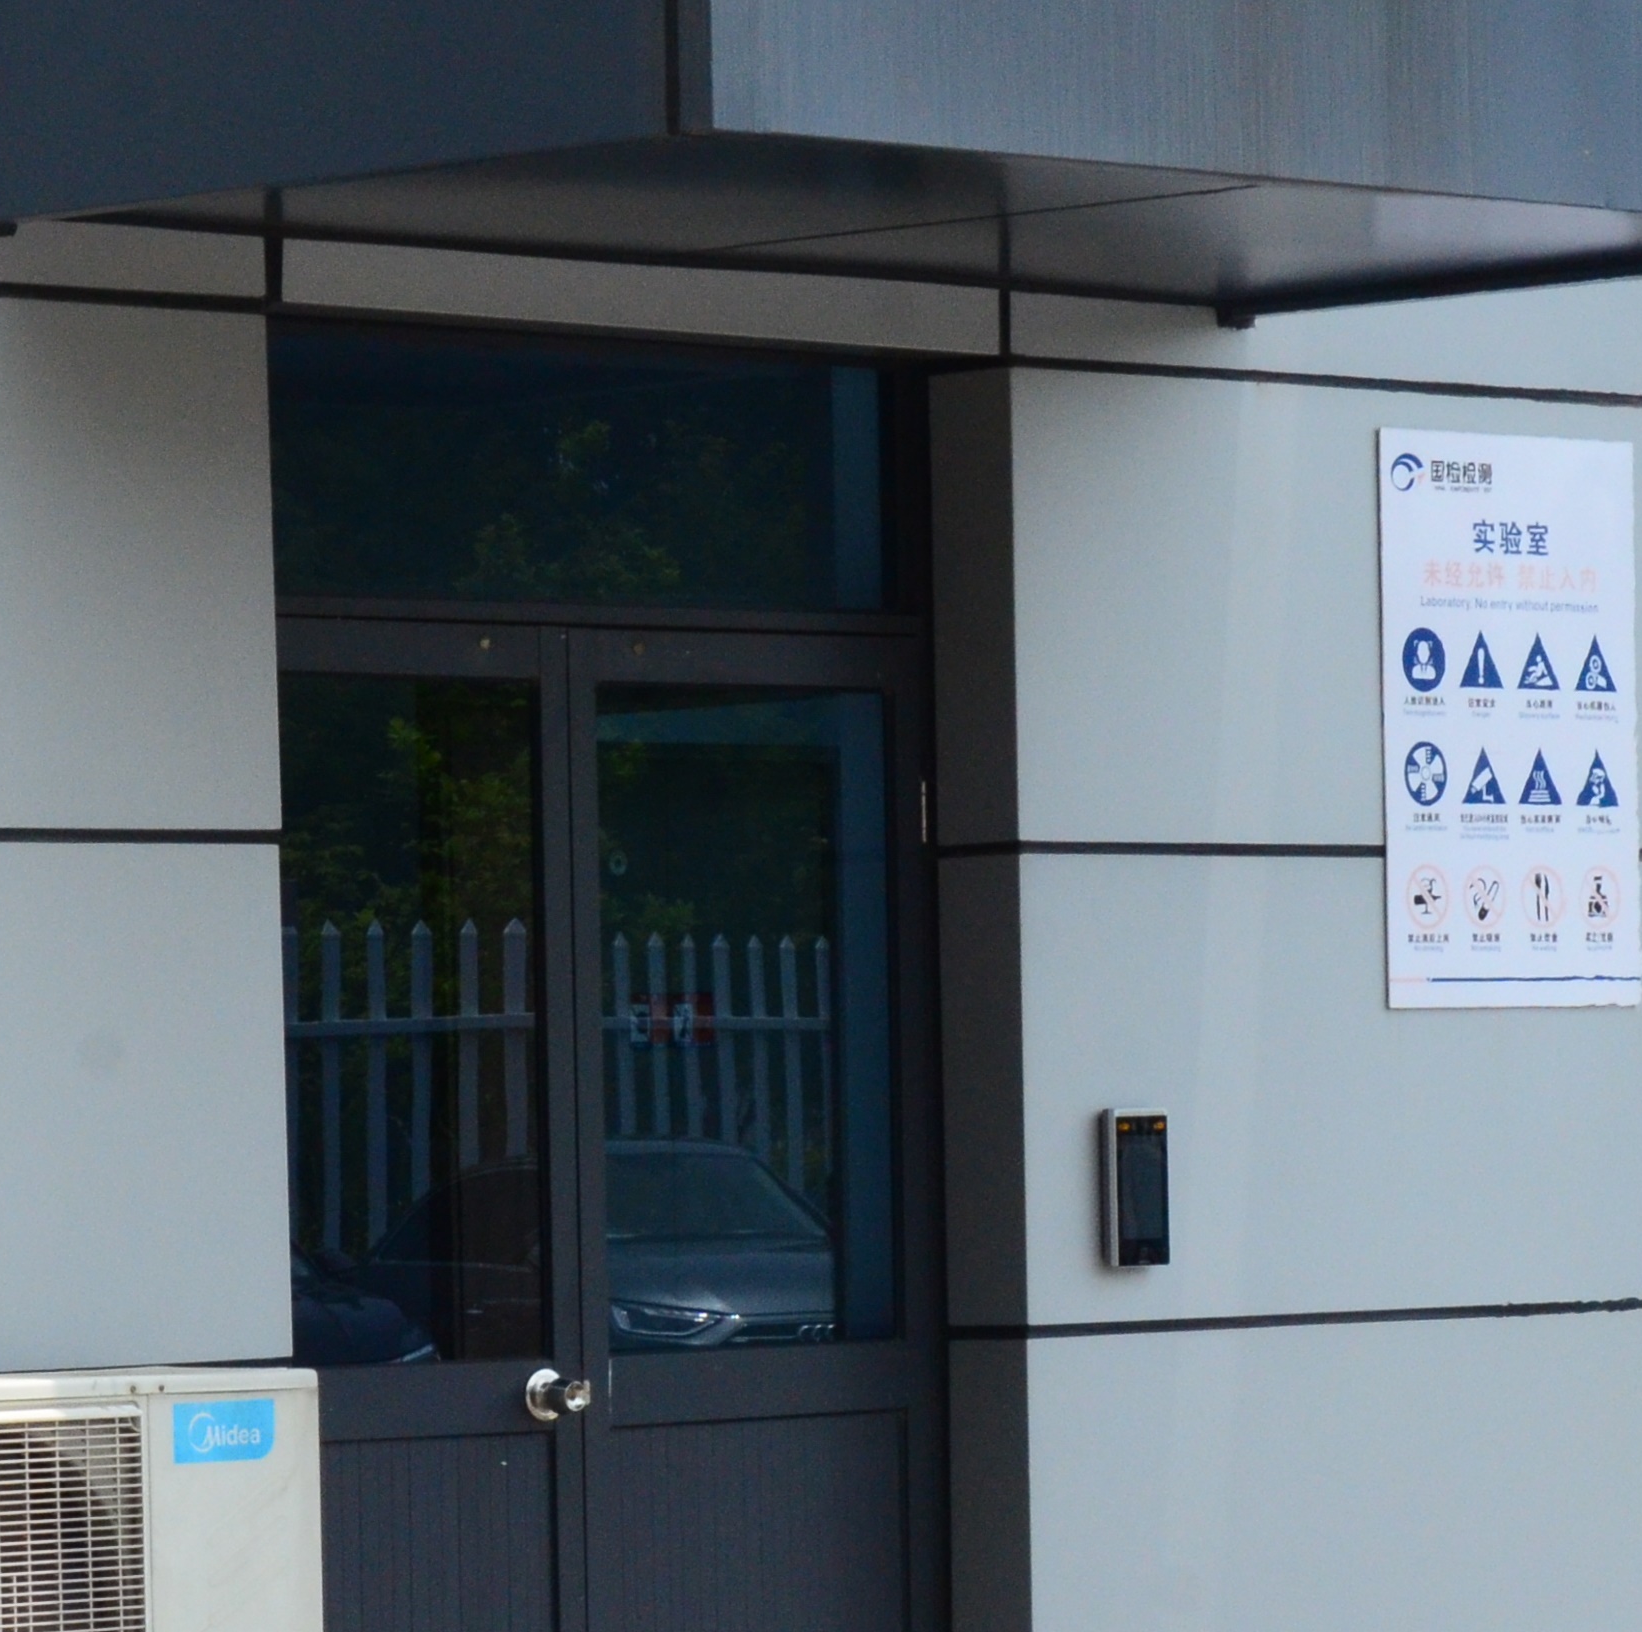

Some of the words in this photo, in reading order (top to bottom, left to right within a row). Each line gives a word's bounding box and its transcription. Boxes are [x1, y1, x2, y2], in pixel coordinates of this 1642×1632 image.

[1431, 460, 1493, 485] 国检检测
[1472, 519, 1549, 556] 实验室
[1423, 559, 1506, 588] 未经允许
[1517, 563, 1597, 592] 禁止入内
[1474, 599, 1488, 609] No
[1515, 600, 1548, 611] without
[1550, 602, 1599, 613] permission
[187, 1412, 261, 1453] Midea
